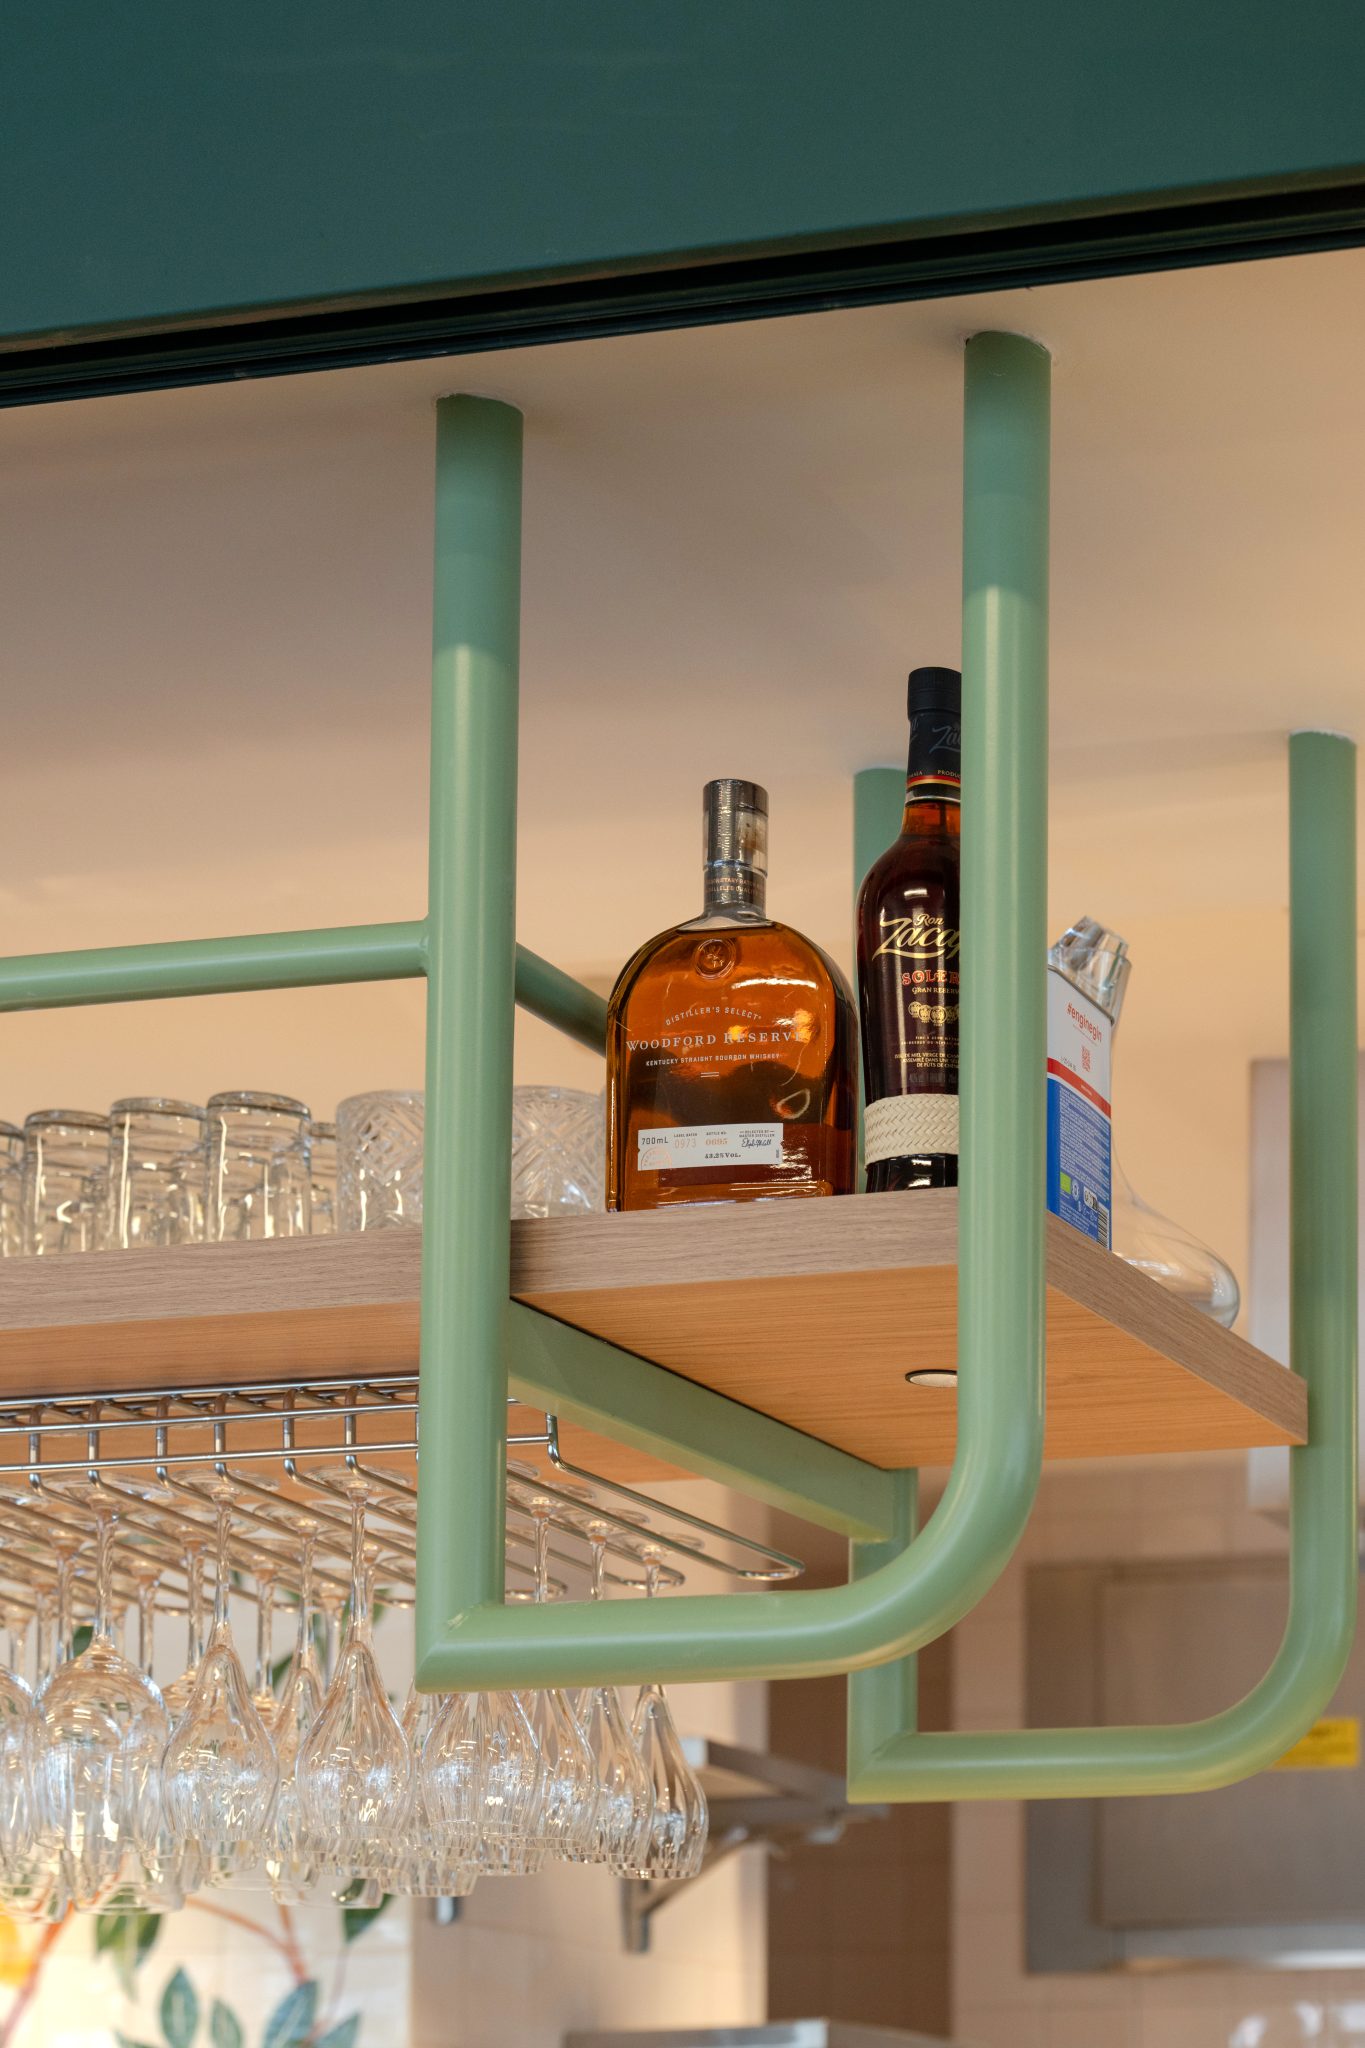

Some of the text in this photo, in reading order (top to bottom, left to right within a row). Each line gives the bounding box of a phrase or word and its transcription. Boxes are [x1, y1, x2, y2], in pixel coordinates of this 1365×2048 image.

[914, 913, 945, 926] Ron
[912, 986, 932, 995] GRAN
[665, 1007, 720, 1026] DISTILLER'S
[1066, 1001, 1102, 1042] #enginegin
[626, 1032, 805, 1051] WOODFORD RESERVE
[646, 1058, 678, 1067] KENTUCKY
[681, 1055, 712, 1064] STRAIGHT
[716, 1054, 746, 1062] BOURBON
[641, 1136, 669, 1145] 700mL
